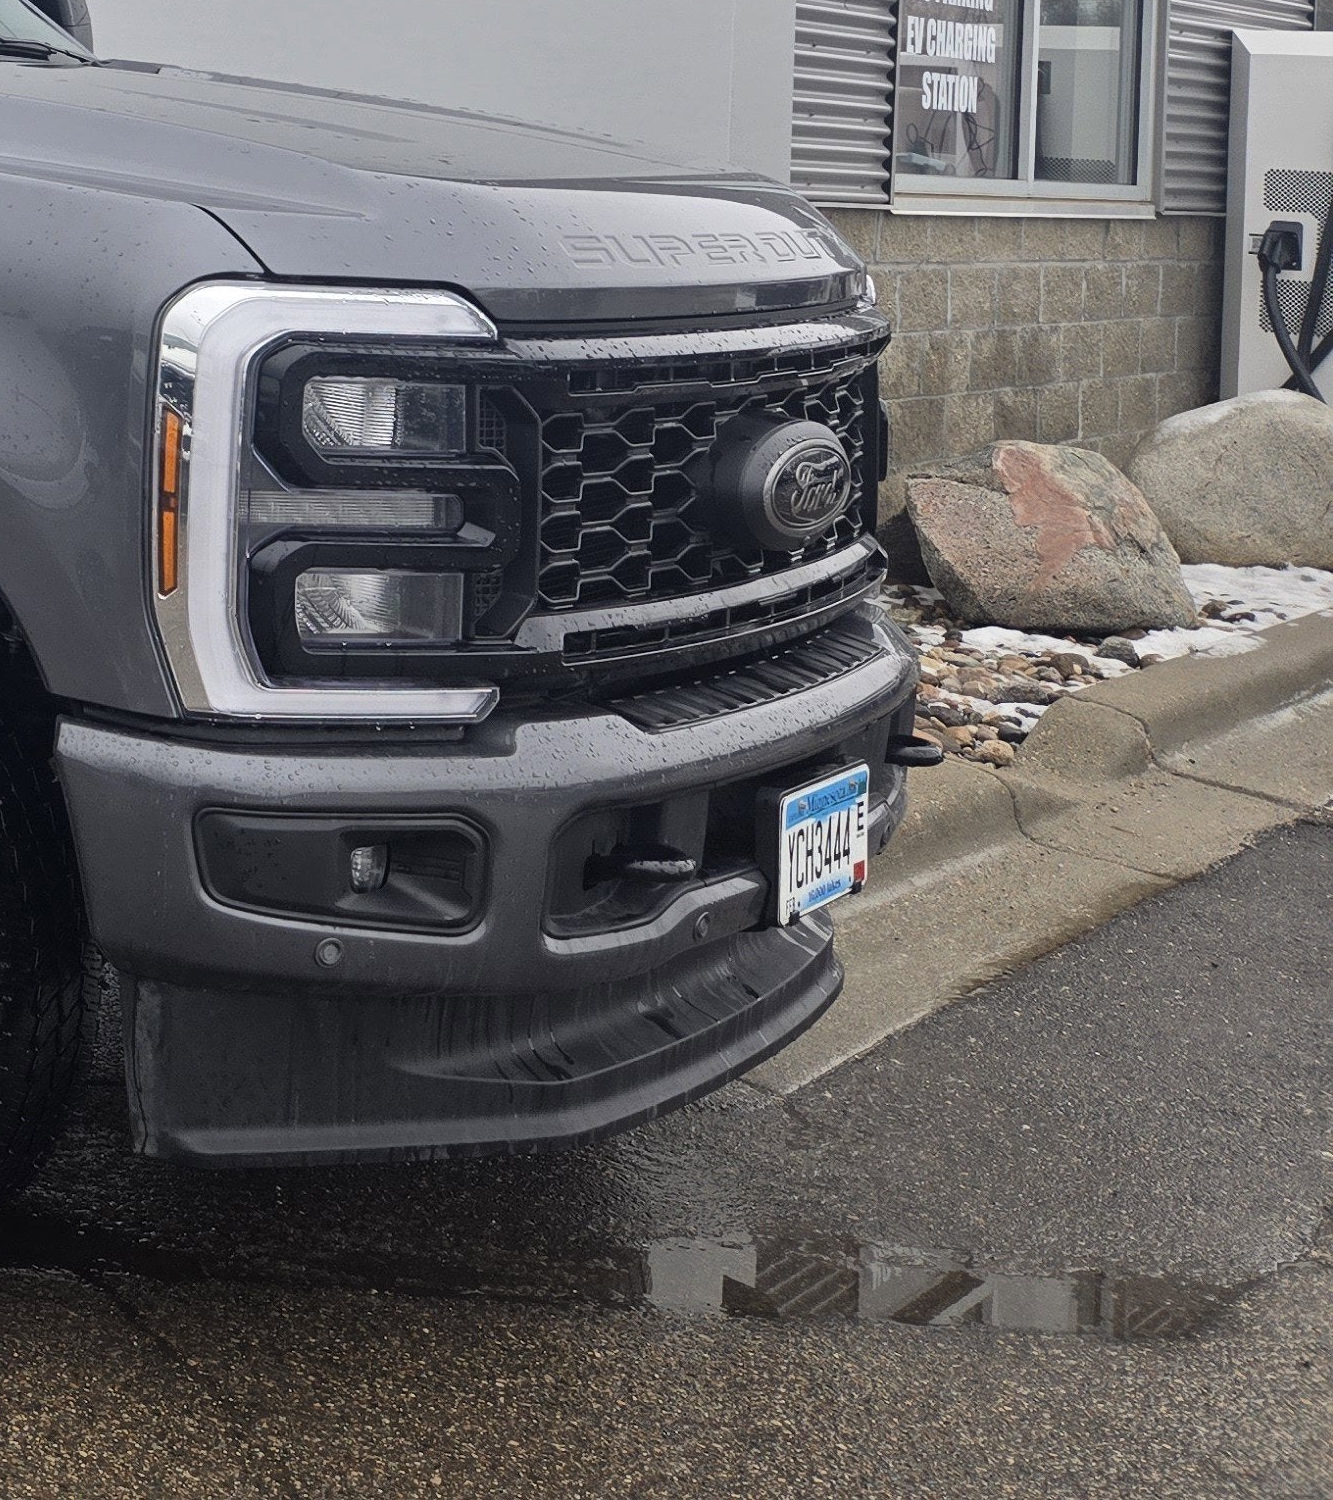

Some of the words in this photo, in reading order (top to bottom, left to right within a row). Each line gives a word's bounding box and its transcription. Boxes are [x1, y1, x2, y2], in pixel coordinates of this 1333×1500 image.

[906, 15, 925, 54] EV
[926, 18, 996, 64] CHARGING
[921, 71, 978, 114] STATION
[561, 232, 768, 268] SUPER
[790, 455, 840, 514] Ford
[788, 807, 850, 893] YCH3444
